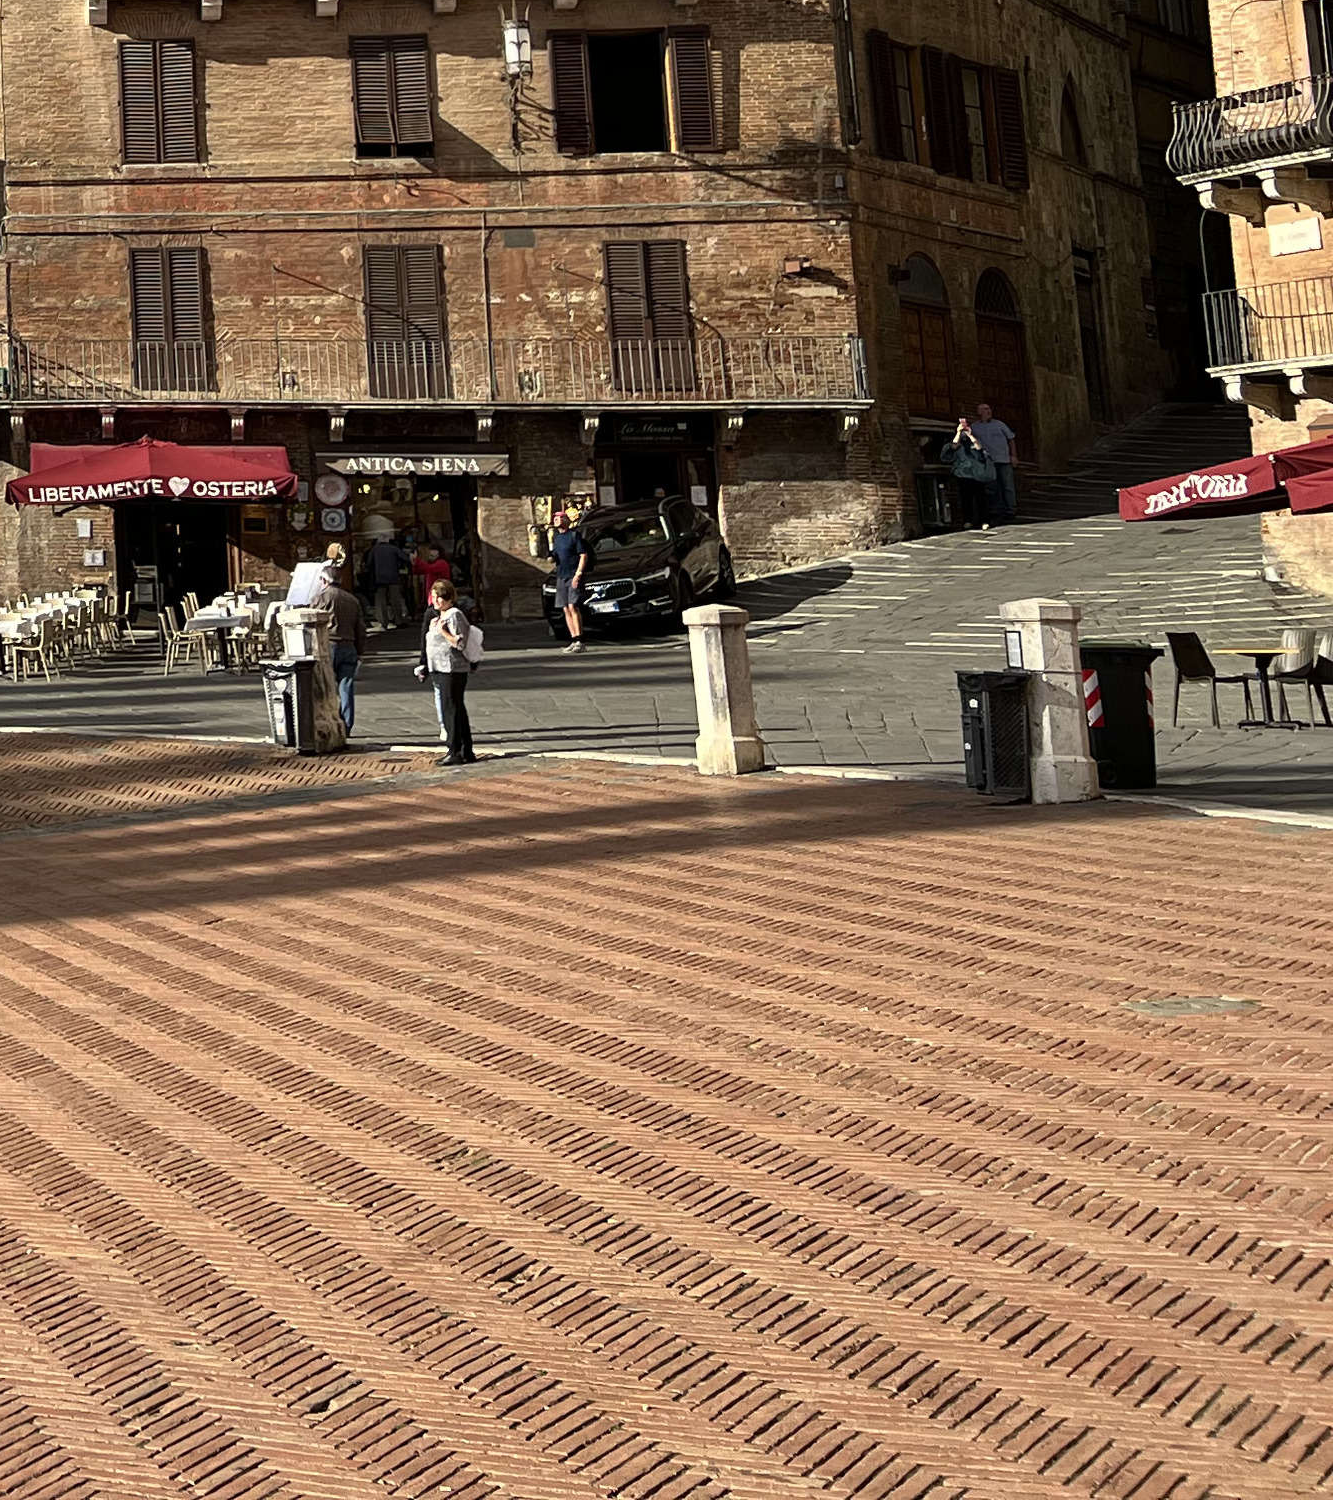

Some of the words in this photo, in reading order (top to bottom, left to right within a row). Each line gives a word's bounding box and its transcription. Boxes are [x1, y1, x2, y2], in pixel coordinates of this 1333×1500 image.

[346, 457, 416, 471] ANTICA
[421, 457, 480, 472] SIENA
[28, 478, 165, 503] LIBERAMENTE
[192, 480, 278, 497] OSTERIA
